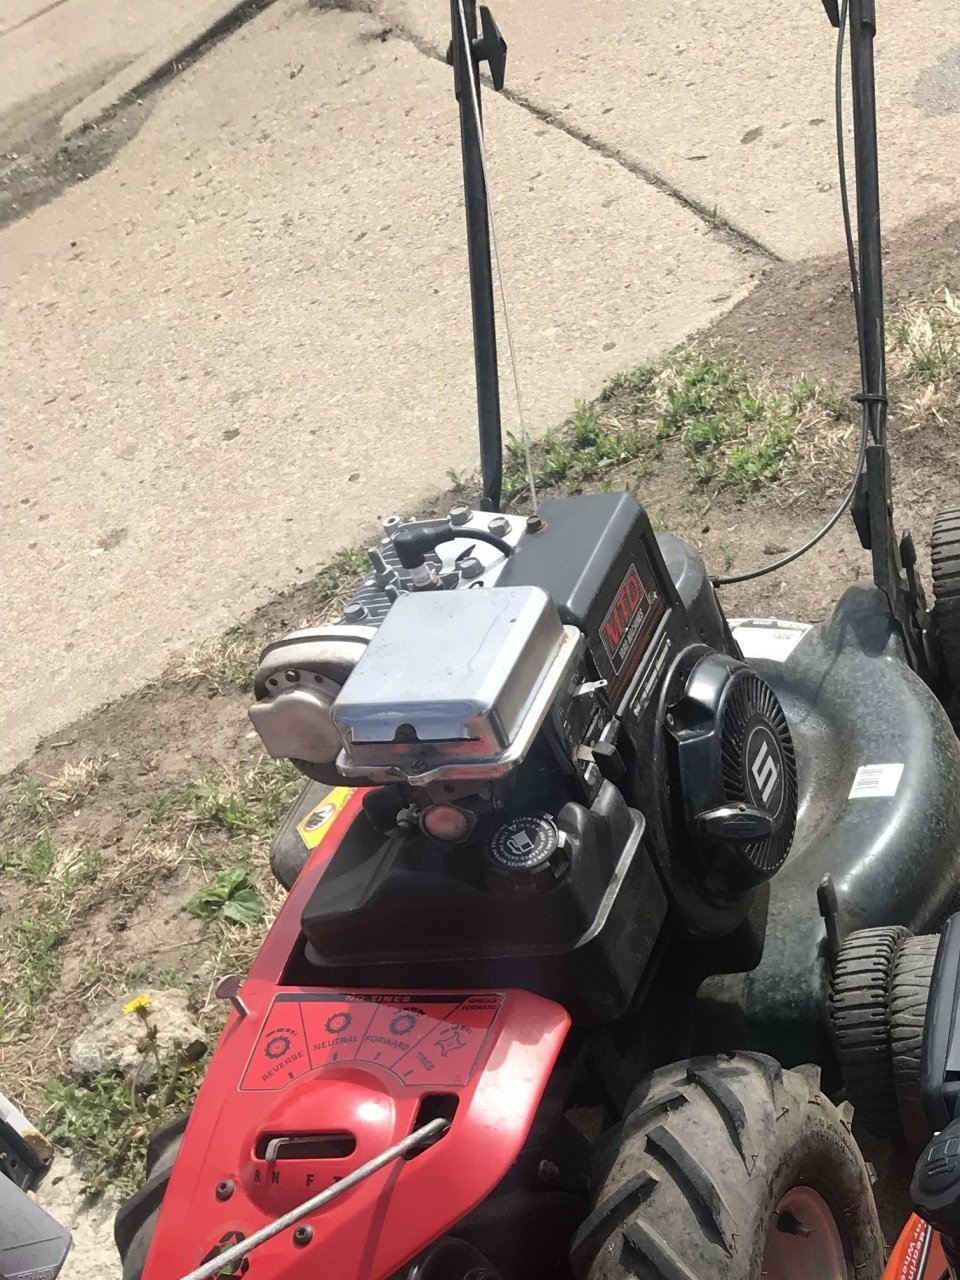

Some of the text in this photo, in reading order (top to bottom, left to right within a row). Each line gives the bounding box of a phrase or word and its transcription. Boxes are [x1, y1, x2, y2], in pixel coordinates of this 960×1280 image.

[605, 575, 640, 646] MTD
[545, 837, 553, 849] COOL
[345, 995, 412, 1003] NO TINES
[313, 1035, 359, 1051] NEUTRAL
[364, 1035, 411, 1051] FORWARD
[261, 1052, 305, 1081] REVERSE
[415, 1052, 435, 1072] TINES
[254, 1169, 261, 1183] R
[270, 1171, 280, 1184] N
[306, 1174, 314, 1187] F
